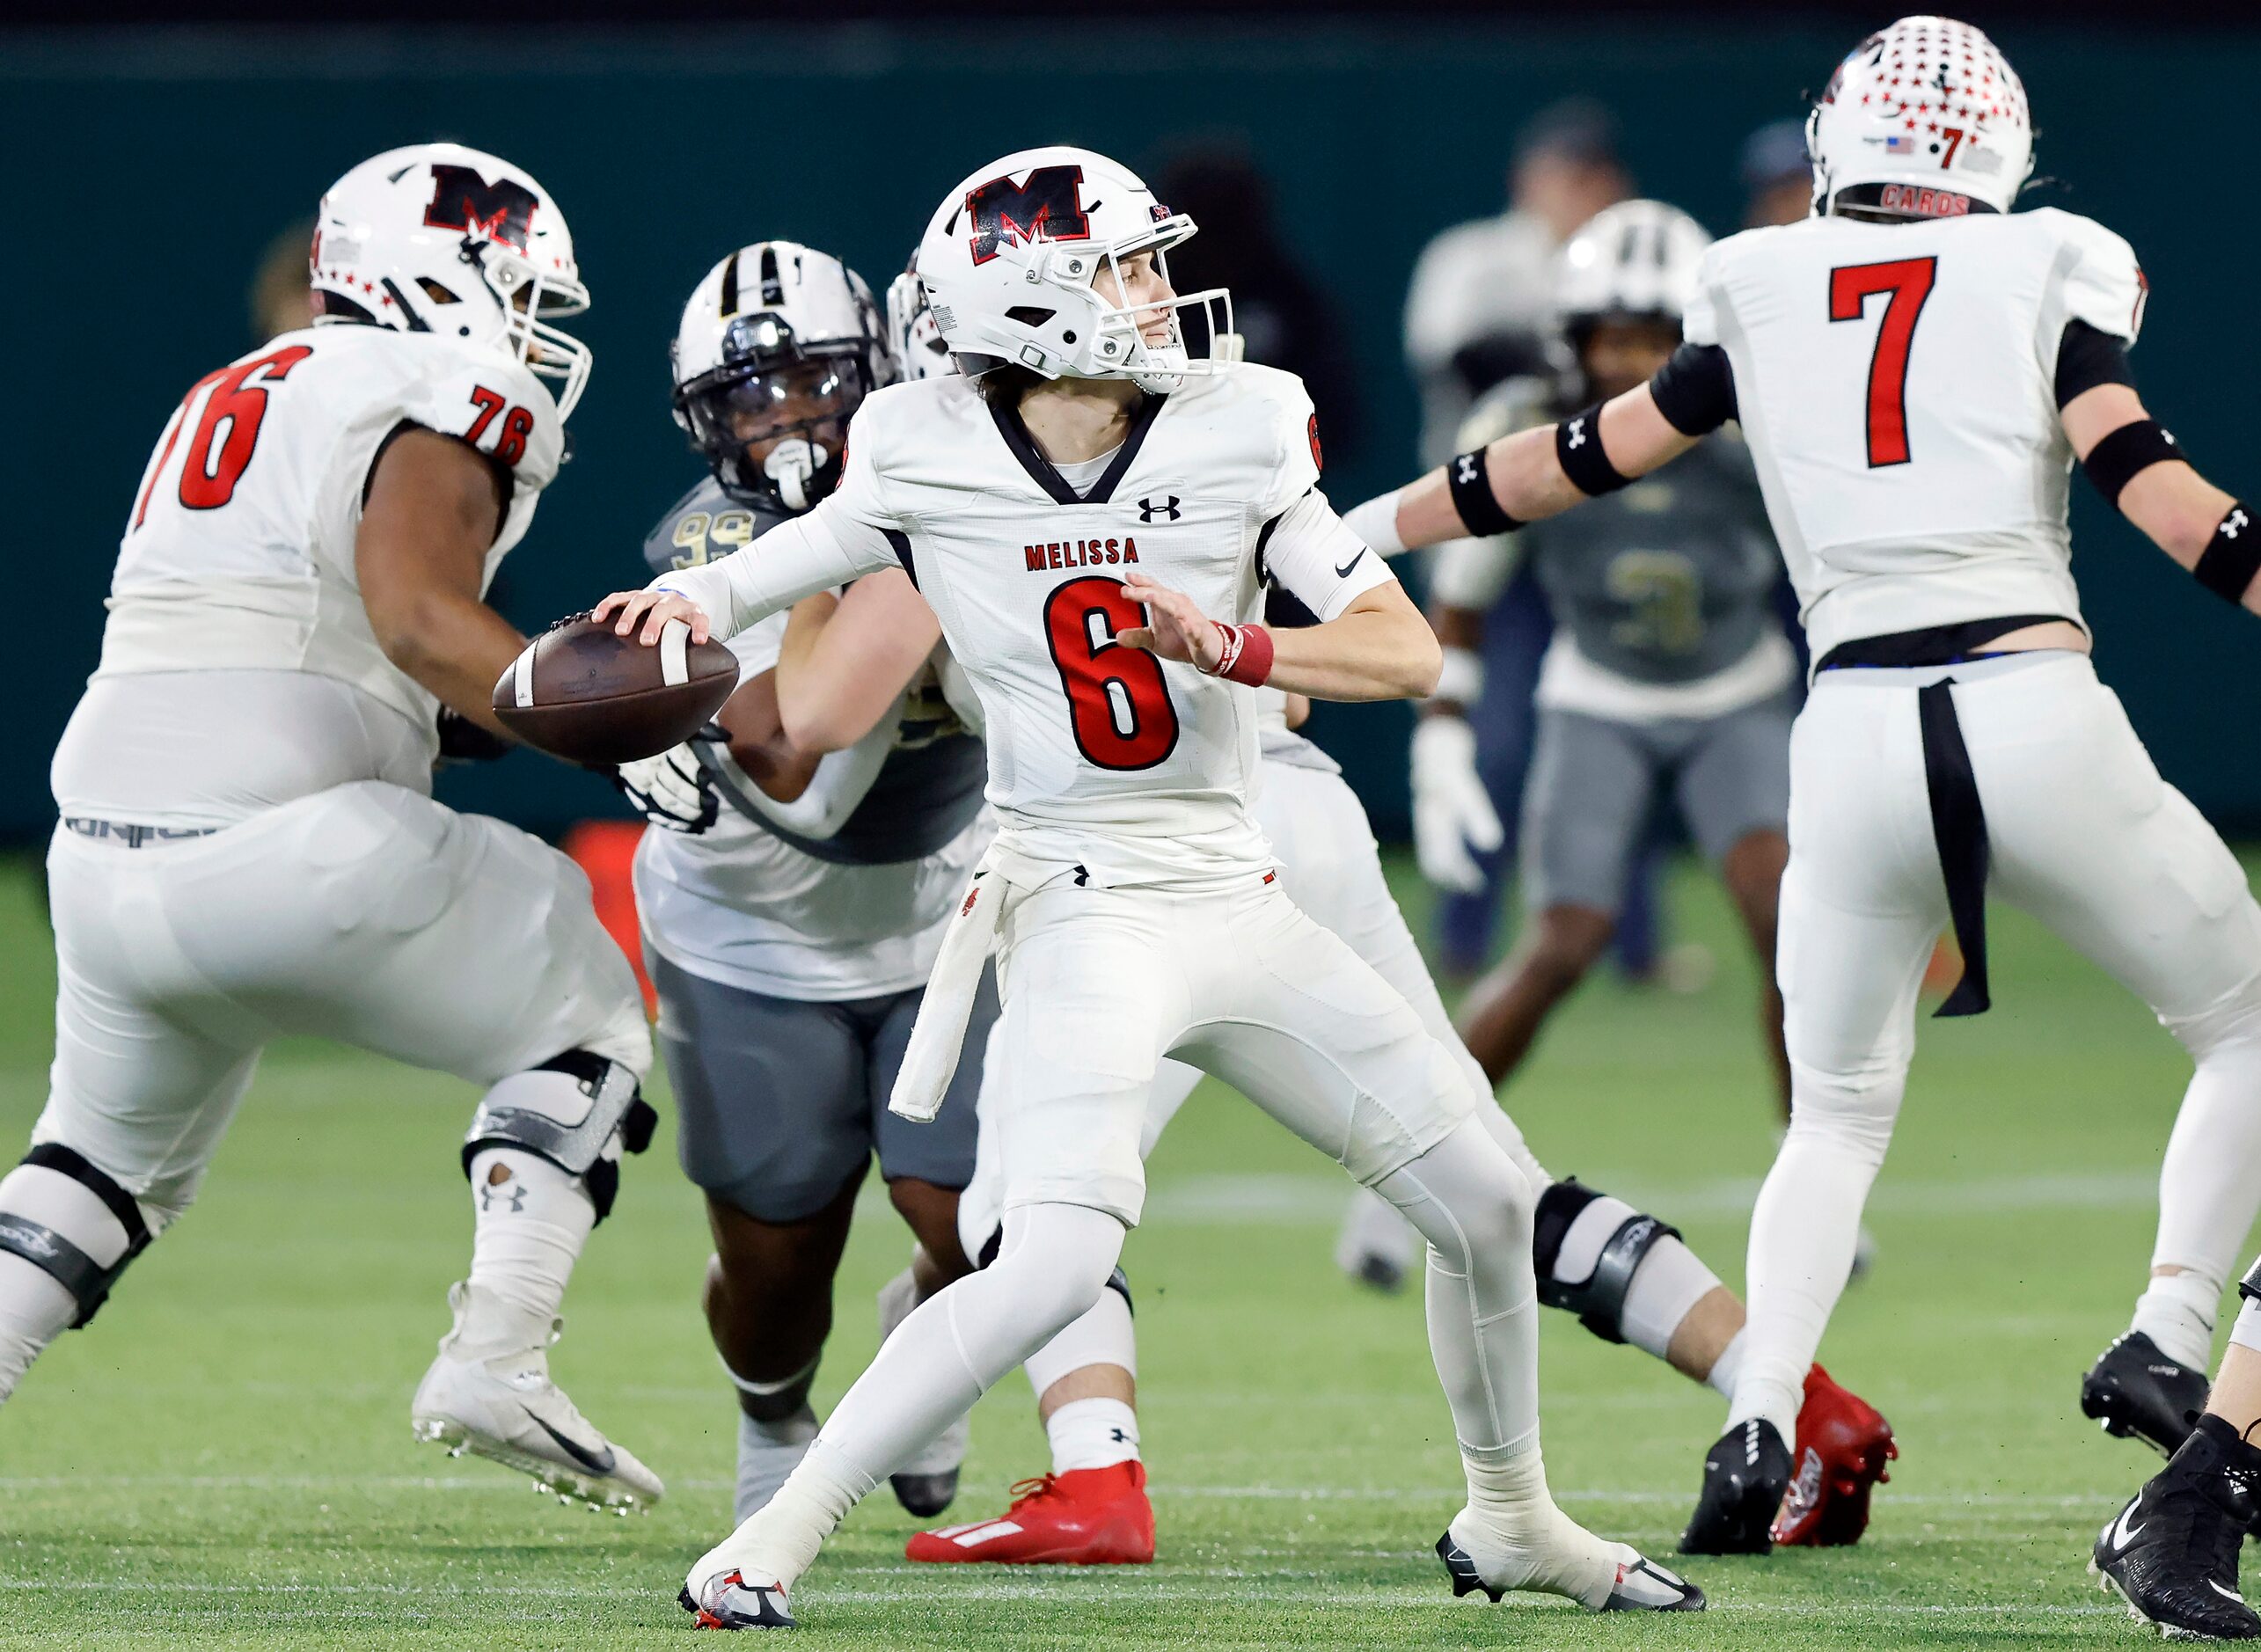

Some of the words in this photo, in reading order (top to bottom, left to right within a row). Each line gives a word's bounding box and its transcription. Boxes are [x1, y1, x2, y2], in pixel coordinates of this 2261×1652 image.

[1940, 127, 1965, 171] 7
[423, 164, 540, 259] M
[966, 164, 1091, 267] M
[1881, 184, 1970, 216] CARDS
[1829, 255, 1937, 468] 7
[463, 384, 534, 467] 76
[1024, 537, 1140, 572] MELISSA
[1043, 574, 1180, 771] 6
